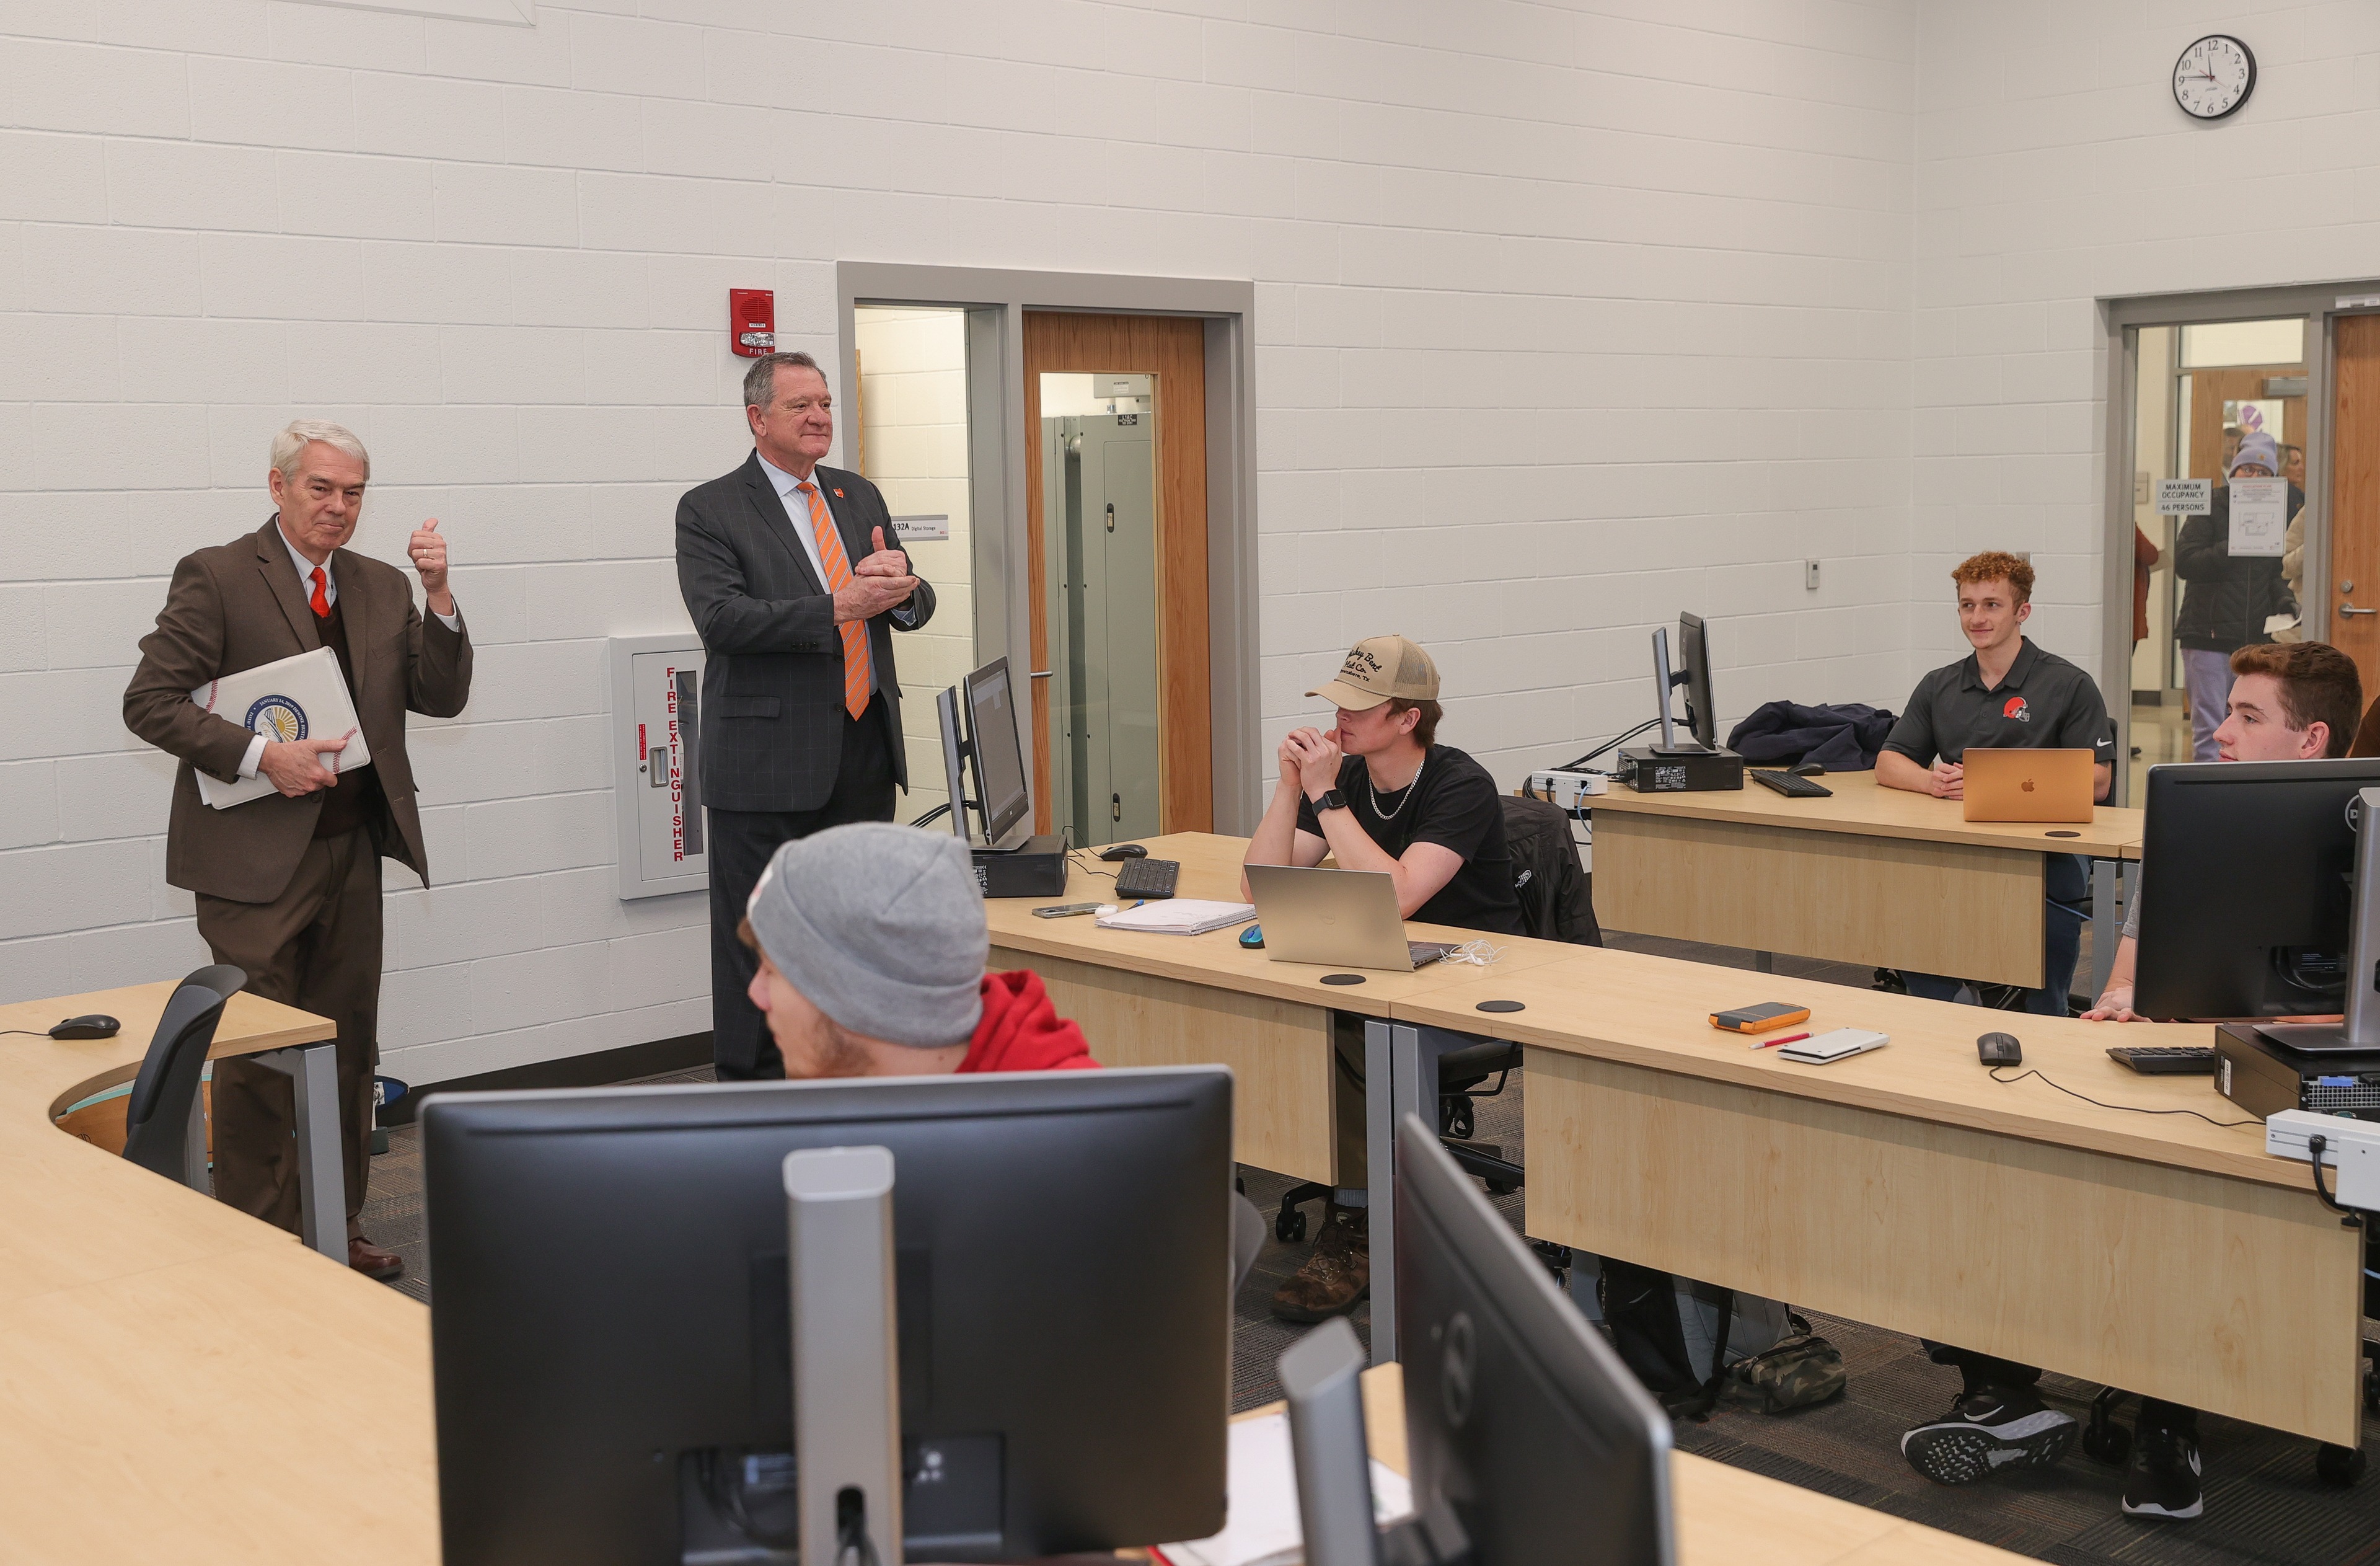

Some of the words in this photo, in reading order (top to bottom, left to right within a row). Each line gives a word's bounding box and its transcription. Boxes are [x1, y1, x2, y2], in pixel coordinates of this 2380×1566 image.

[2207, 40, 2218, 51] 12
[2224, 44, 2229, 54] 1
[2195, 46, 2202, 58] 11
[2234, 53, 2241, 64] 2
[2181, 60, 2191, 71] 10
[2239, 68, 2245, 79] 3
[2178, 76, 2185, 87] 9
[2182, 90, 2188, 100] 8
[2233, 84, 2239, 95] 4
[2193, 101, 2200, 112] 7
[2207, 103, 2214, 113] 6
[2221, 98, 2228, 108] 5
[1364, 653, 1382, 672] Bent
[1355, 664, 1367, 673] Co.
[667, 667, 677, 714] FIRE
[259, 698, 280, 706] JANUARY
[298, 724, 306, 740] HUSTE
[668, 720, 684, 862] EXTINGUISHER
